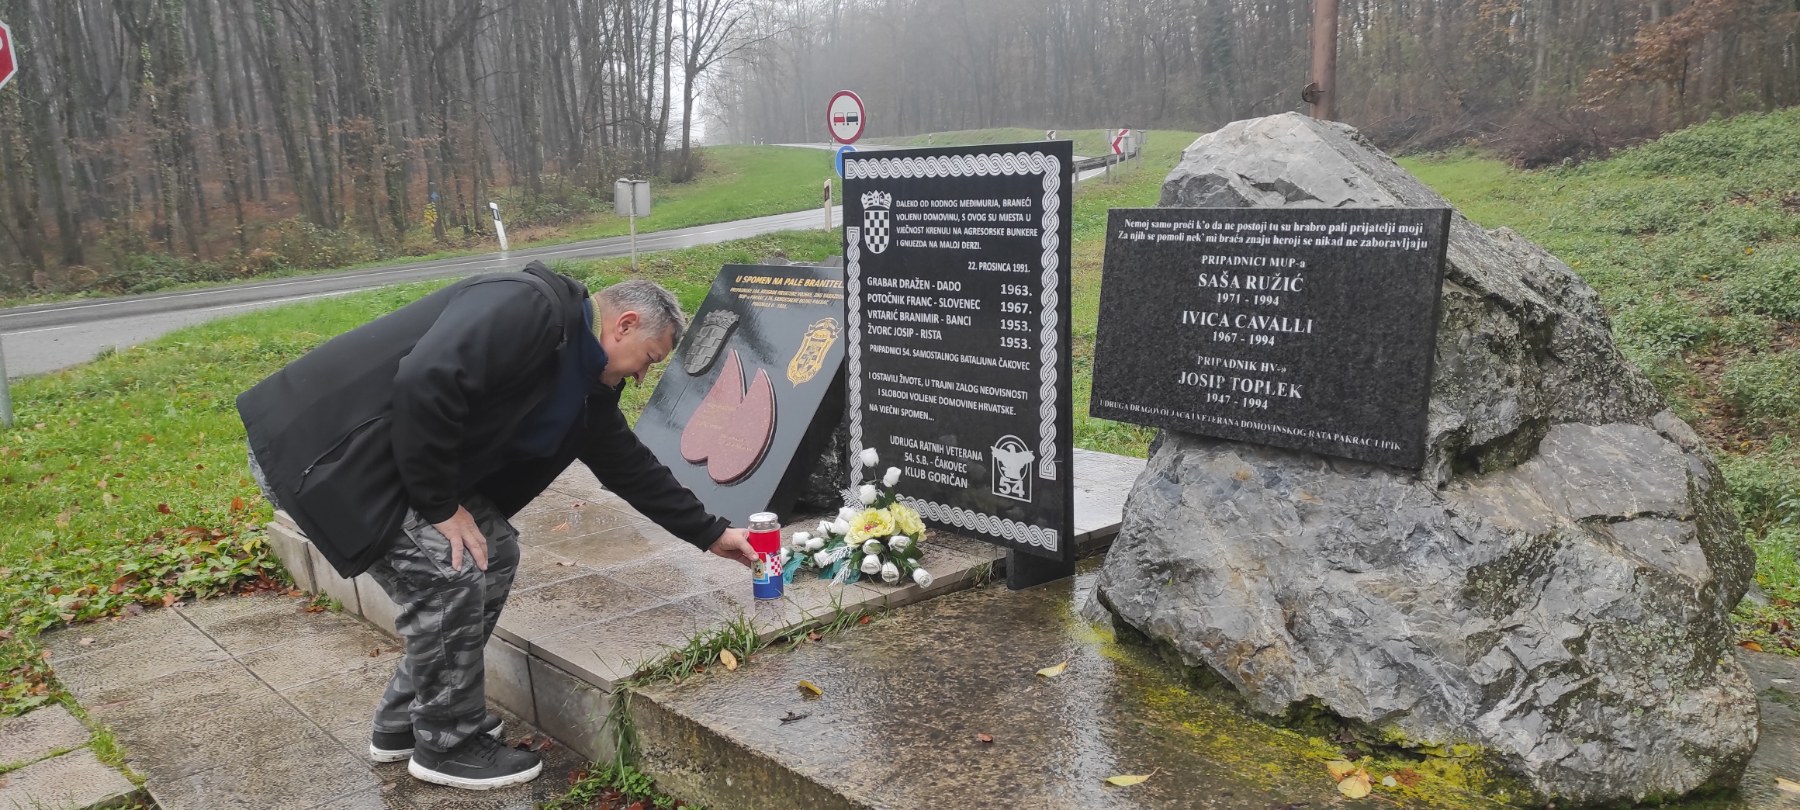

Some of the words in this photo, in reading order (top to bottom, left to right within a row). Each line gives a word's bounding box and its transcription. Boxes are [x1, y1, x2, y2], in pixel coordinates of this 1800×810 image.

[896, 200, 918, 208] DALEKO
[919, 200, 929, 208] OD
[930, 199, 958, 208] RODNOG
[1002, 197, 1032, 207] BRANEĆI
[896, 213, 922, 221] VOLJENU
[923, 213, 960, 222] DOMOVINU,
[961, 213, 966, 221] S
[967, 213, 987, 222] OVOG
[988, 213, 997, 222] SU
[999, 213, 1024, 222] MJESTA
[1025, 213, 1032, 222] U
[896, 225, 924, 234] VJEČNOST
[925, 226, 951, 235] KRENULI
[952, 227, 962, 235] NA
[963, 227, 1005, 236] AGRESORSKE
[1006, 227, 1039, 237] BUNKERE
[1124, 218, 1150, 230] Nemoj
[1150, 219, 1172, 229] samo
[1173, 219, 1195, 231] proći
[1211, 221, 1223, 230] da
[1224, 222, 1235, 231] ne
[1236, 221, 1267, 233] postoji
[1269, 222, 1279, 232] tu
[1280, 223, 1291, 232] su
[1293, 221, 1327, 232] hrabro
[1328, 222, 1348, 235] pali
[1349, 222, 1396, 236] prijatelji
[1398, 223, 1424, 236] moji
[900, 239, 928, 248] GNIJEZDA
[928, 240, 938, 248] NA
[939, 240, 960, 249] MALOJ
[961, 241, 982, 250] DERZI.
[1118, 230, 1128, 240] Za
[1130, 231, 1146, 242] njih
[1147, 232, 1156, 240] se
[1157, 232, 1185, 242] pomoli
[1206, 233, 1218, 243] mi
[1219, 233, 1244, 244] braća
[1245, 235, 1271, 247] znaju
[1273, 234, 1301, 248] heroji
[1302, 236, 1314, 246] se
[1315, 236, 1344, 248] nikad
[1345, 238, 1359, 247] ne
[1360, 236, 1429, 251] zaboravljaju
[967, 261, 978, 271] 22.
[978, 262, 1011, 272] PROSINCA
[1012, 263, 1031, 273] 1991.
[1201, 254, 1266, 266] PRIPADNICI
[1269, 257, 1306, 269] MUP-a
[735, 275, 743, 283] U
[742, 275, 772, 284] SPOMEN
[772, 277, 784, 285] NA
[784, 277, 804, 286] PALE
[867, 276, 898, 288] GRABAR
[899, 277, 931, 290] DRAŽEN
[936, 280, 961, 292] DADO
[1198, 270, 1241, 289] SAŠA
[1246, 272, 1304, 293] RUŽIĆ
[1000, 284, 1033, 297] 1963.
[867, 292, 905, 305] POTOČNIK
[906, 295, 933, 307] FRANC
[938, 298, 981, 310] SLOVENEC
[1217, 293, 1241, 304] 1971
[1254, 295, 1280, 306] 1994
[1000, 301, 1033, 315] 1967.
[867, 308, 899, 321] VRTARIĆ
[899, 311, 940, 324] BRANIMIR
[945, 315, 972, 326] BANCI
[1182, 310, 1230, 328] IVICA
[1234, 314, 1313, 334] CAVALLI
[867, 323, 893, 336] ŽVORC
[893, 326, 914, 338] JOSIP
[920, 329, 942, 341] RISTA
[1000, 319, 1032, 332] 1953.
[1000, 336, 1032, 350] 1953.
[1212, 331, 1238, 343] 1967
[1249, 334, 1275, 347] 1994
[869, 344, 902, 355] PRIPADNICI
[902, 348, 912, 357] 54.
[912, 349, 959, 363] SAMOSTALNOG
[960, 355, 997, 367] BATALJUNA
[998, 357, 1031, 371] ČAKOVEC
[1197, 355, 1257, 371] PRIPADNIK
[872, 372, 899, 383] OSTAVILI
[899, 374, 924, 387] ŽIVOTE,
[924, 378, 930, 387] U
[931, 379, 955, 391] TRAJNI
[955, 382, 979, 394] ZALOG
[979, 385, 1028, 401] NEOVISNOSTI
[1177, 371, 1226, 389] JOSIP
[1230, 376, 1303, 399] TOPLEK
[869, 403, 879, 412] NA
[879, 404, 900, 416] VJEČNI
[881, 389, 909, 400] SLOBODI
[909, 392, 938, 404] VOLJENE
[938, 396, 978, 410] DOMOVINE
[978, 402, 1017, 416] HRVATSKE.
[1206, 393, 1231, 404] 1947
[1242, 397, 1268, 410] 1994
[890, 435, 918, 449] UDRUGA
[919, 440, 945, 454] RATNIH
[945, 445, 984, 462] VETERANA
[904, 452, 915, 463] 54.
[915, 455, 929, 466] S.B.
[934, 455, 968, 474] ČAKOVEC
[904, 465, 927, 480] KLUB
[927, 470, 968, 489] GORIČAN
[998, 477, 1026, 498] 54
